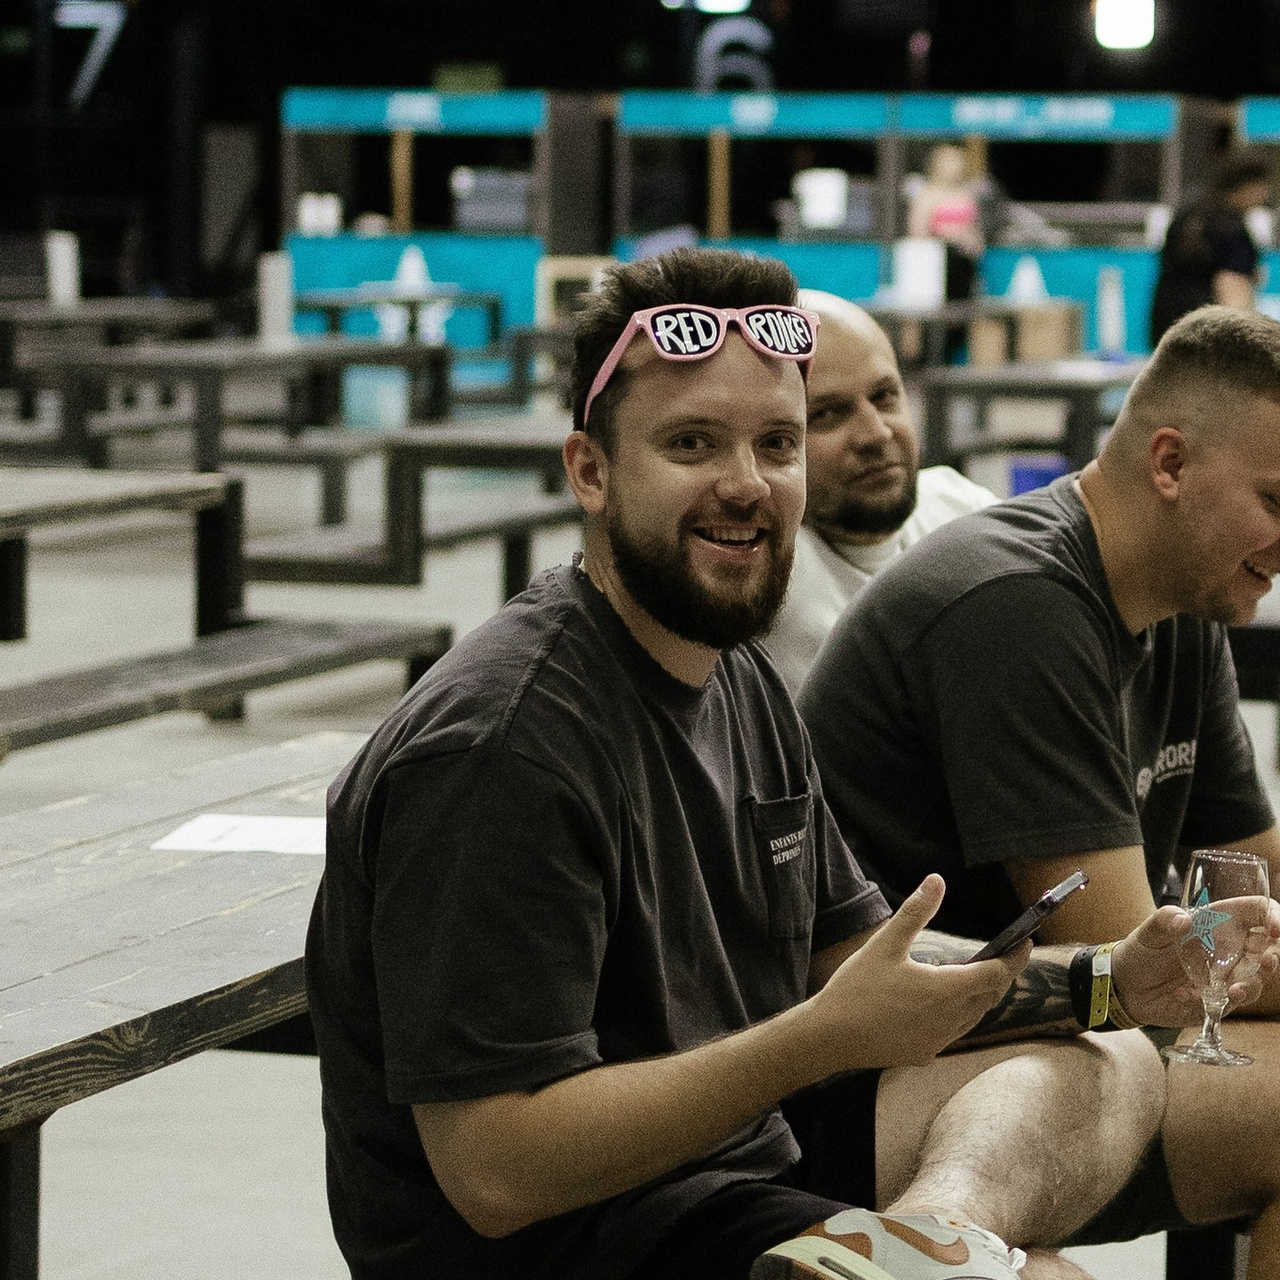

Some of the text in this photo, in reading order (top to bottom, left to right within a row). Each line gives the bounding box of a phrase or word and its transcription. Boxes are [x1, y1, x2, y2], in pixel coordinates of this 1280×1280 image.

[54, 1, 126, 107] 7
[698, 16, 773, 93] 6
[656, 311, 718, 354] RED
